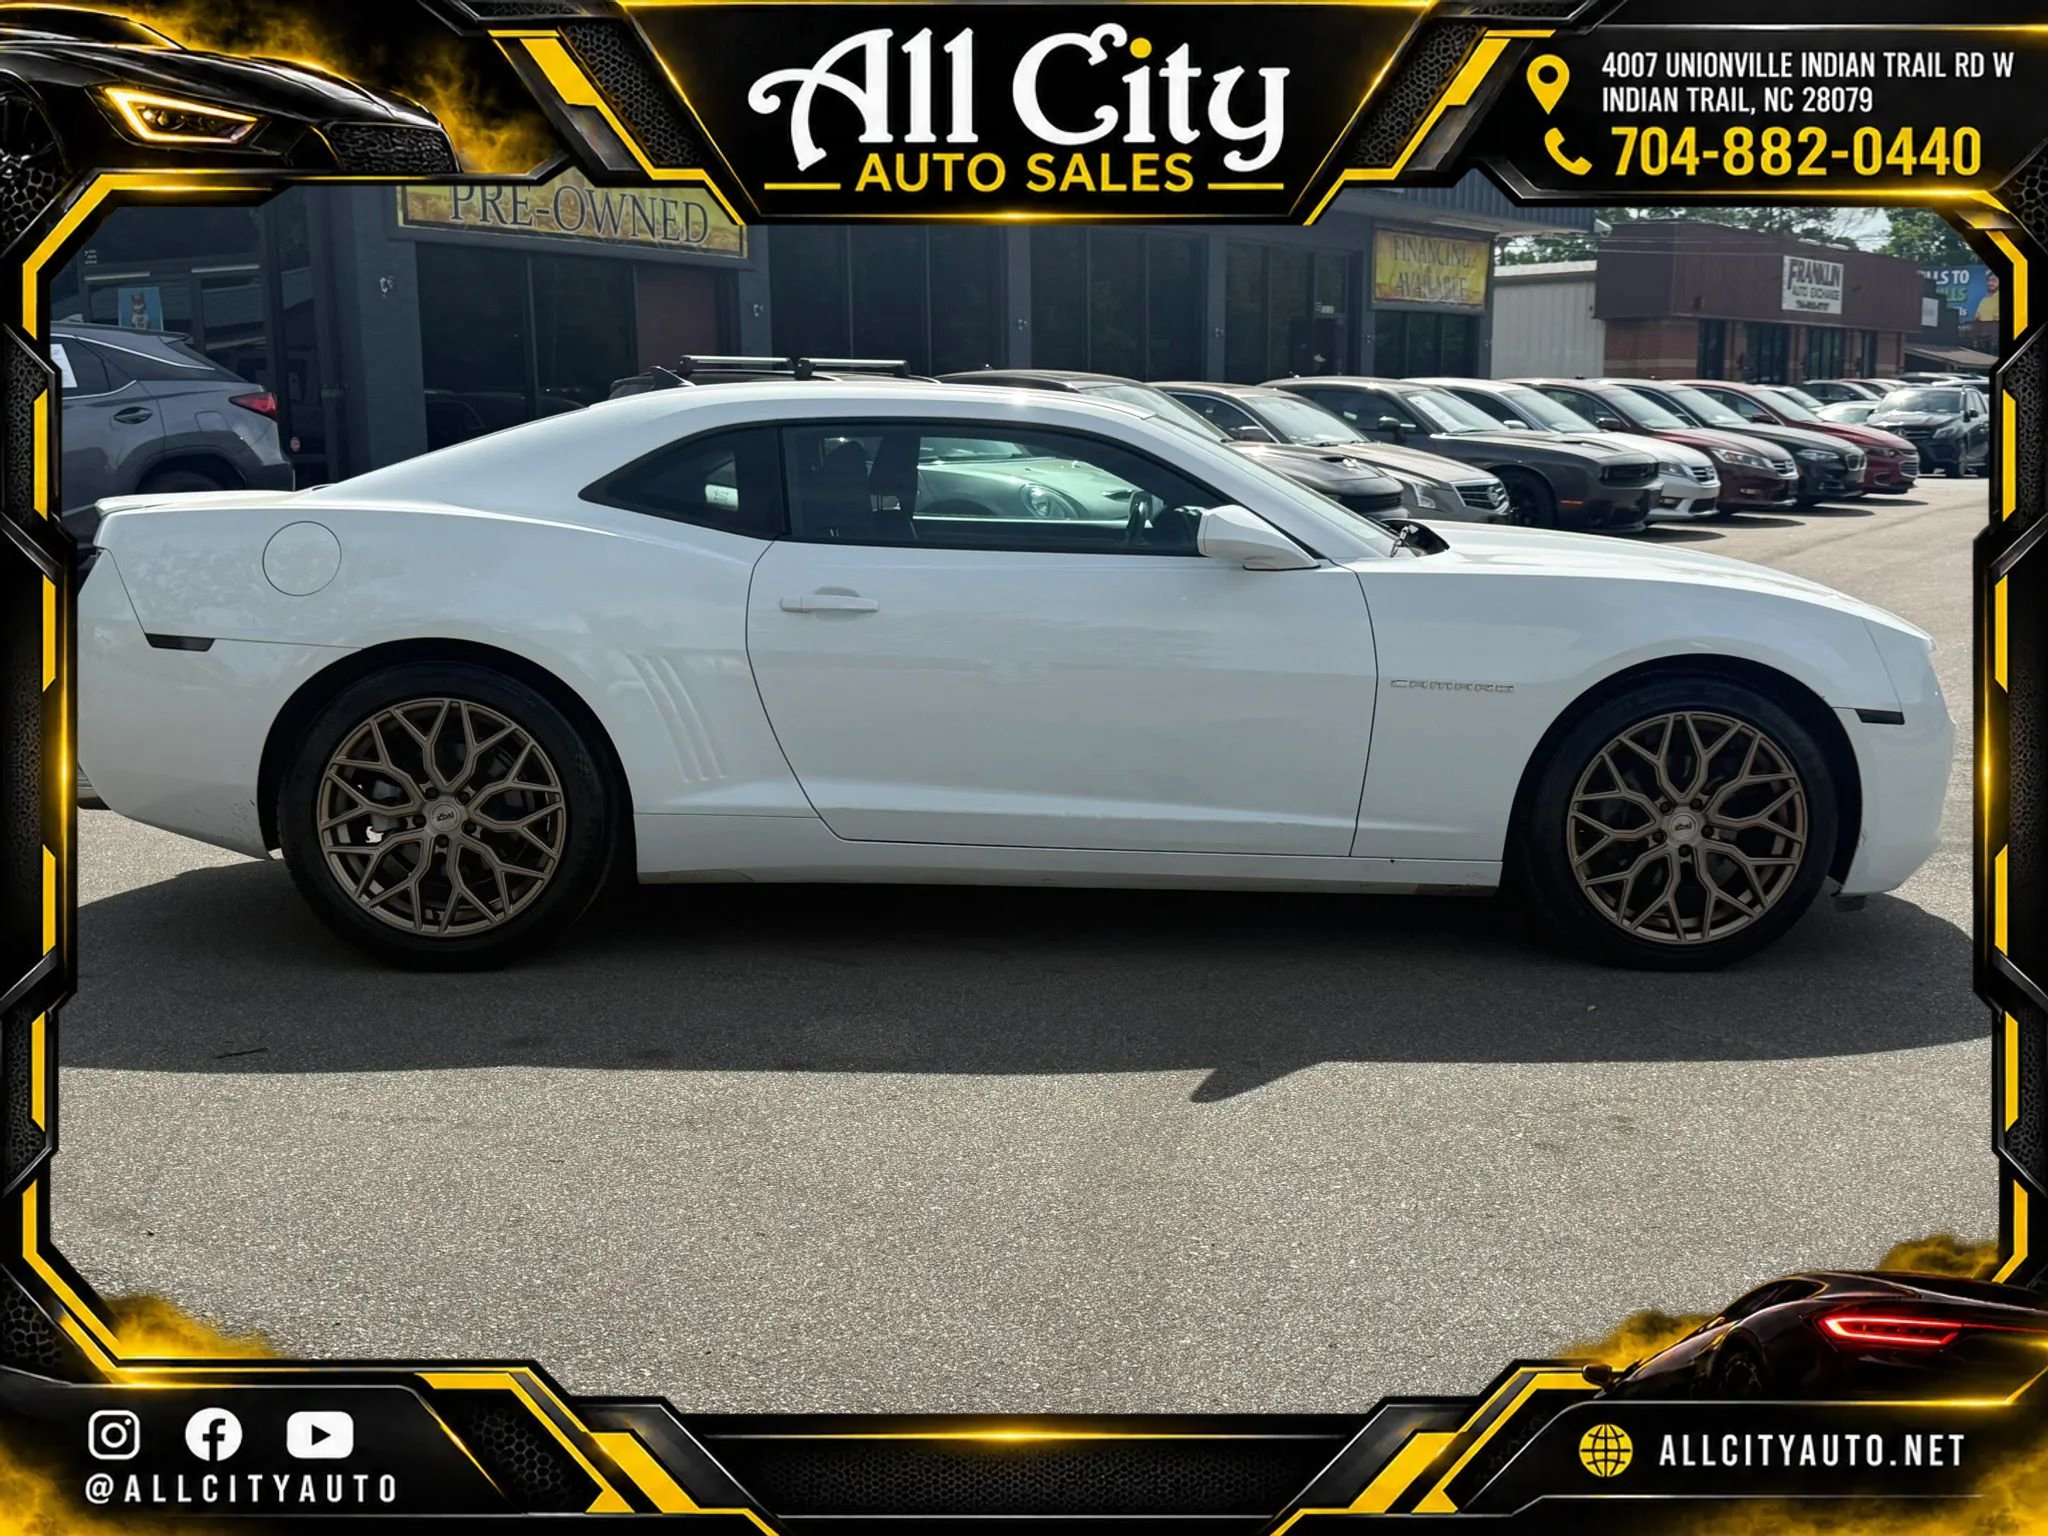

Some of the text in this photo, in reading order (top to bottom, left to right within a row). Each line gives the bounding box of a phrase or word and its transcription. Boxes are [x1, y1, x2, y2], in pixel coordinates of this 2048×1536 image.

[450, 185, 709, 244] PRE-OWNED
[1394, 234, 1472, 269] FINANCING
[1787, 258, 1840, 290] FRANKLIN
[1951, 269, 1970, 285] TO
[1390, 679, 1515, 694] CAMARO
